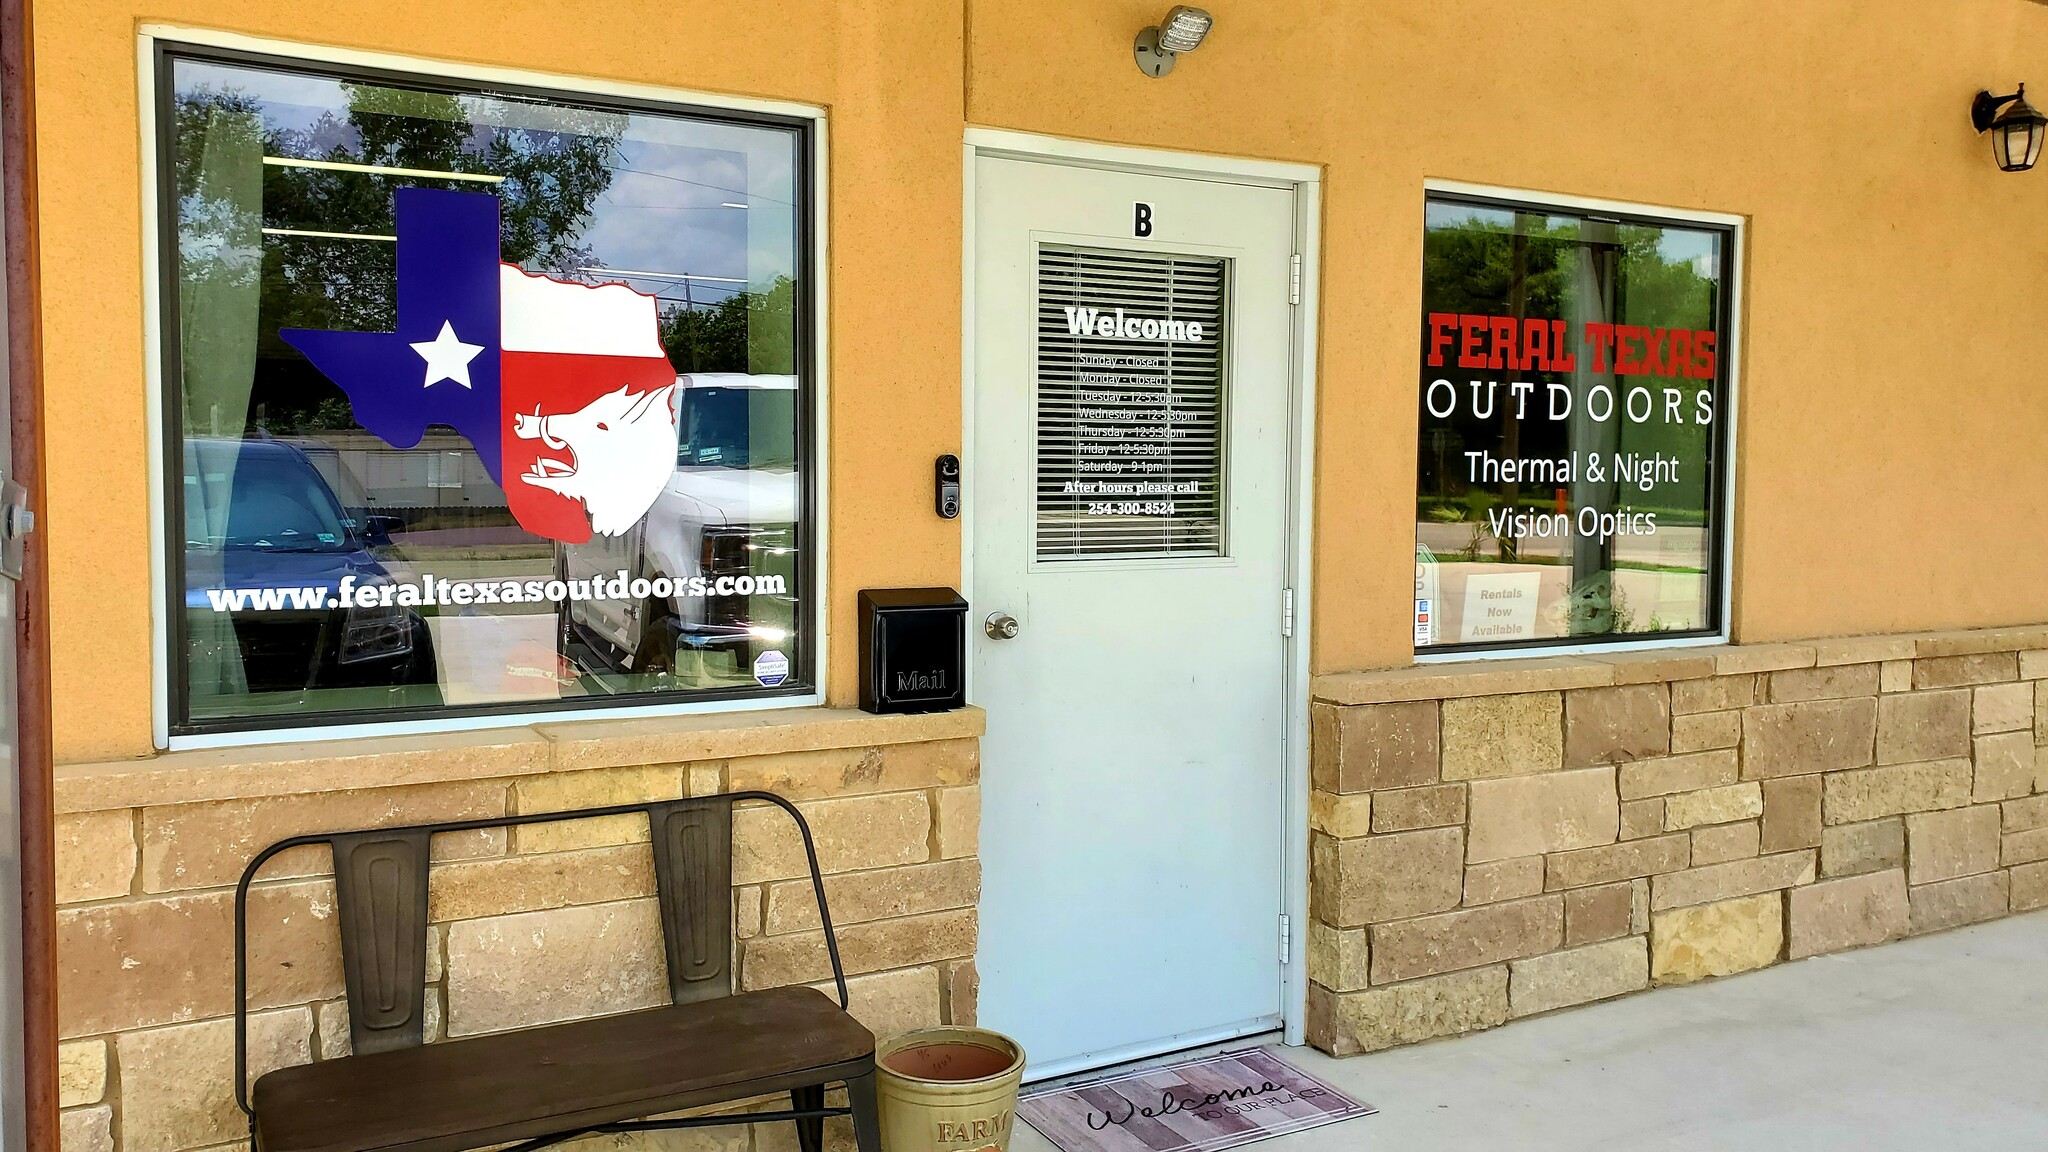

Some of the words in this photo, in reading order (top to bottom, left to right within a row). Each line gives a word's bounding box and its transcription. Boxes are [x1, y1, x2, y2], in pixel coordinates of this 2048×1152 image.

[1135, 203, 1152, 237] B
[1064, 307, 1202, 341] Welcome
[1428, 312, 1575, 372] FERAL
[1585, 322, 1716, 379] TEXAS
[1079, 355, 1118, 368] Sunday
[1126, 356, 1159, 367] Closed
[1080, 373, 1120, 386] Monday
[1129, 374, 1162, 385] Closed
[1079, 390, 1121, 404] Tuesday
[1131, 391, 1182, 404] 12-5:30pm
[1427, 379, 1712, 425] OUTDOORS
[1078, 408, 1137, 422] Wednesday
[1146, 409, 1197, 422] 12-5:30pm
[1079, 426, 1125, 439] Thursday
[1135, 427, 1186, 439] 12-5:30pm
[1078, 443, 1109, 457] Friday
[1118, 444, 1170, 457] 12-5:30pm
[1078, 461, 1123, 475] Saturday
[1465, 450, 1577, 483] Thermal
[1586, 452, 1605, 483] &
[1614, 452, 1679, 492] Night
[1063, 481, 1097, 493] After
[1099, 481, 1134, 493] hours
[1136, 482, 1174, 496] please
[1177, 481, 1198, 493] call
[1088, 502, 1175, 515] 254-300-8524
[1488, 507, 1569, 538] Vision
[1578, 506, 1656, 545] Optics
[207, 569, 786, 612] www.feraltexasoutdoors.com
[1481, 589, 1522, 600] Rentals
[1488, 608, 1512, 618] Now
[1472, 624, 1522, 636] Available
[897, 670, 946, 691] Mail
[1087, 1080, 1284, 1131] Welcome
[1192, 1109, 1223, 1122] TO
[1228, 1101, 1262, 1119] OUR
[1265, 1087, 1326, 1109] PLACE
[938, 1110, 1009, 1142] FARM
